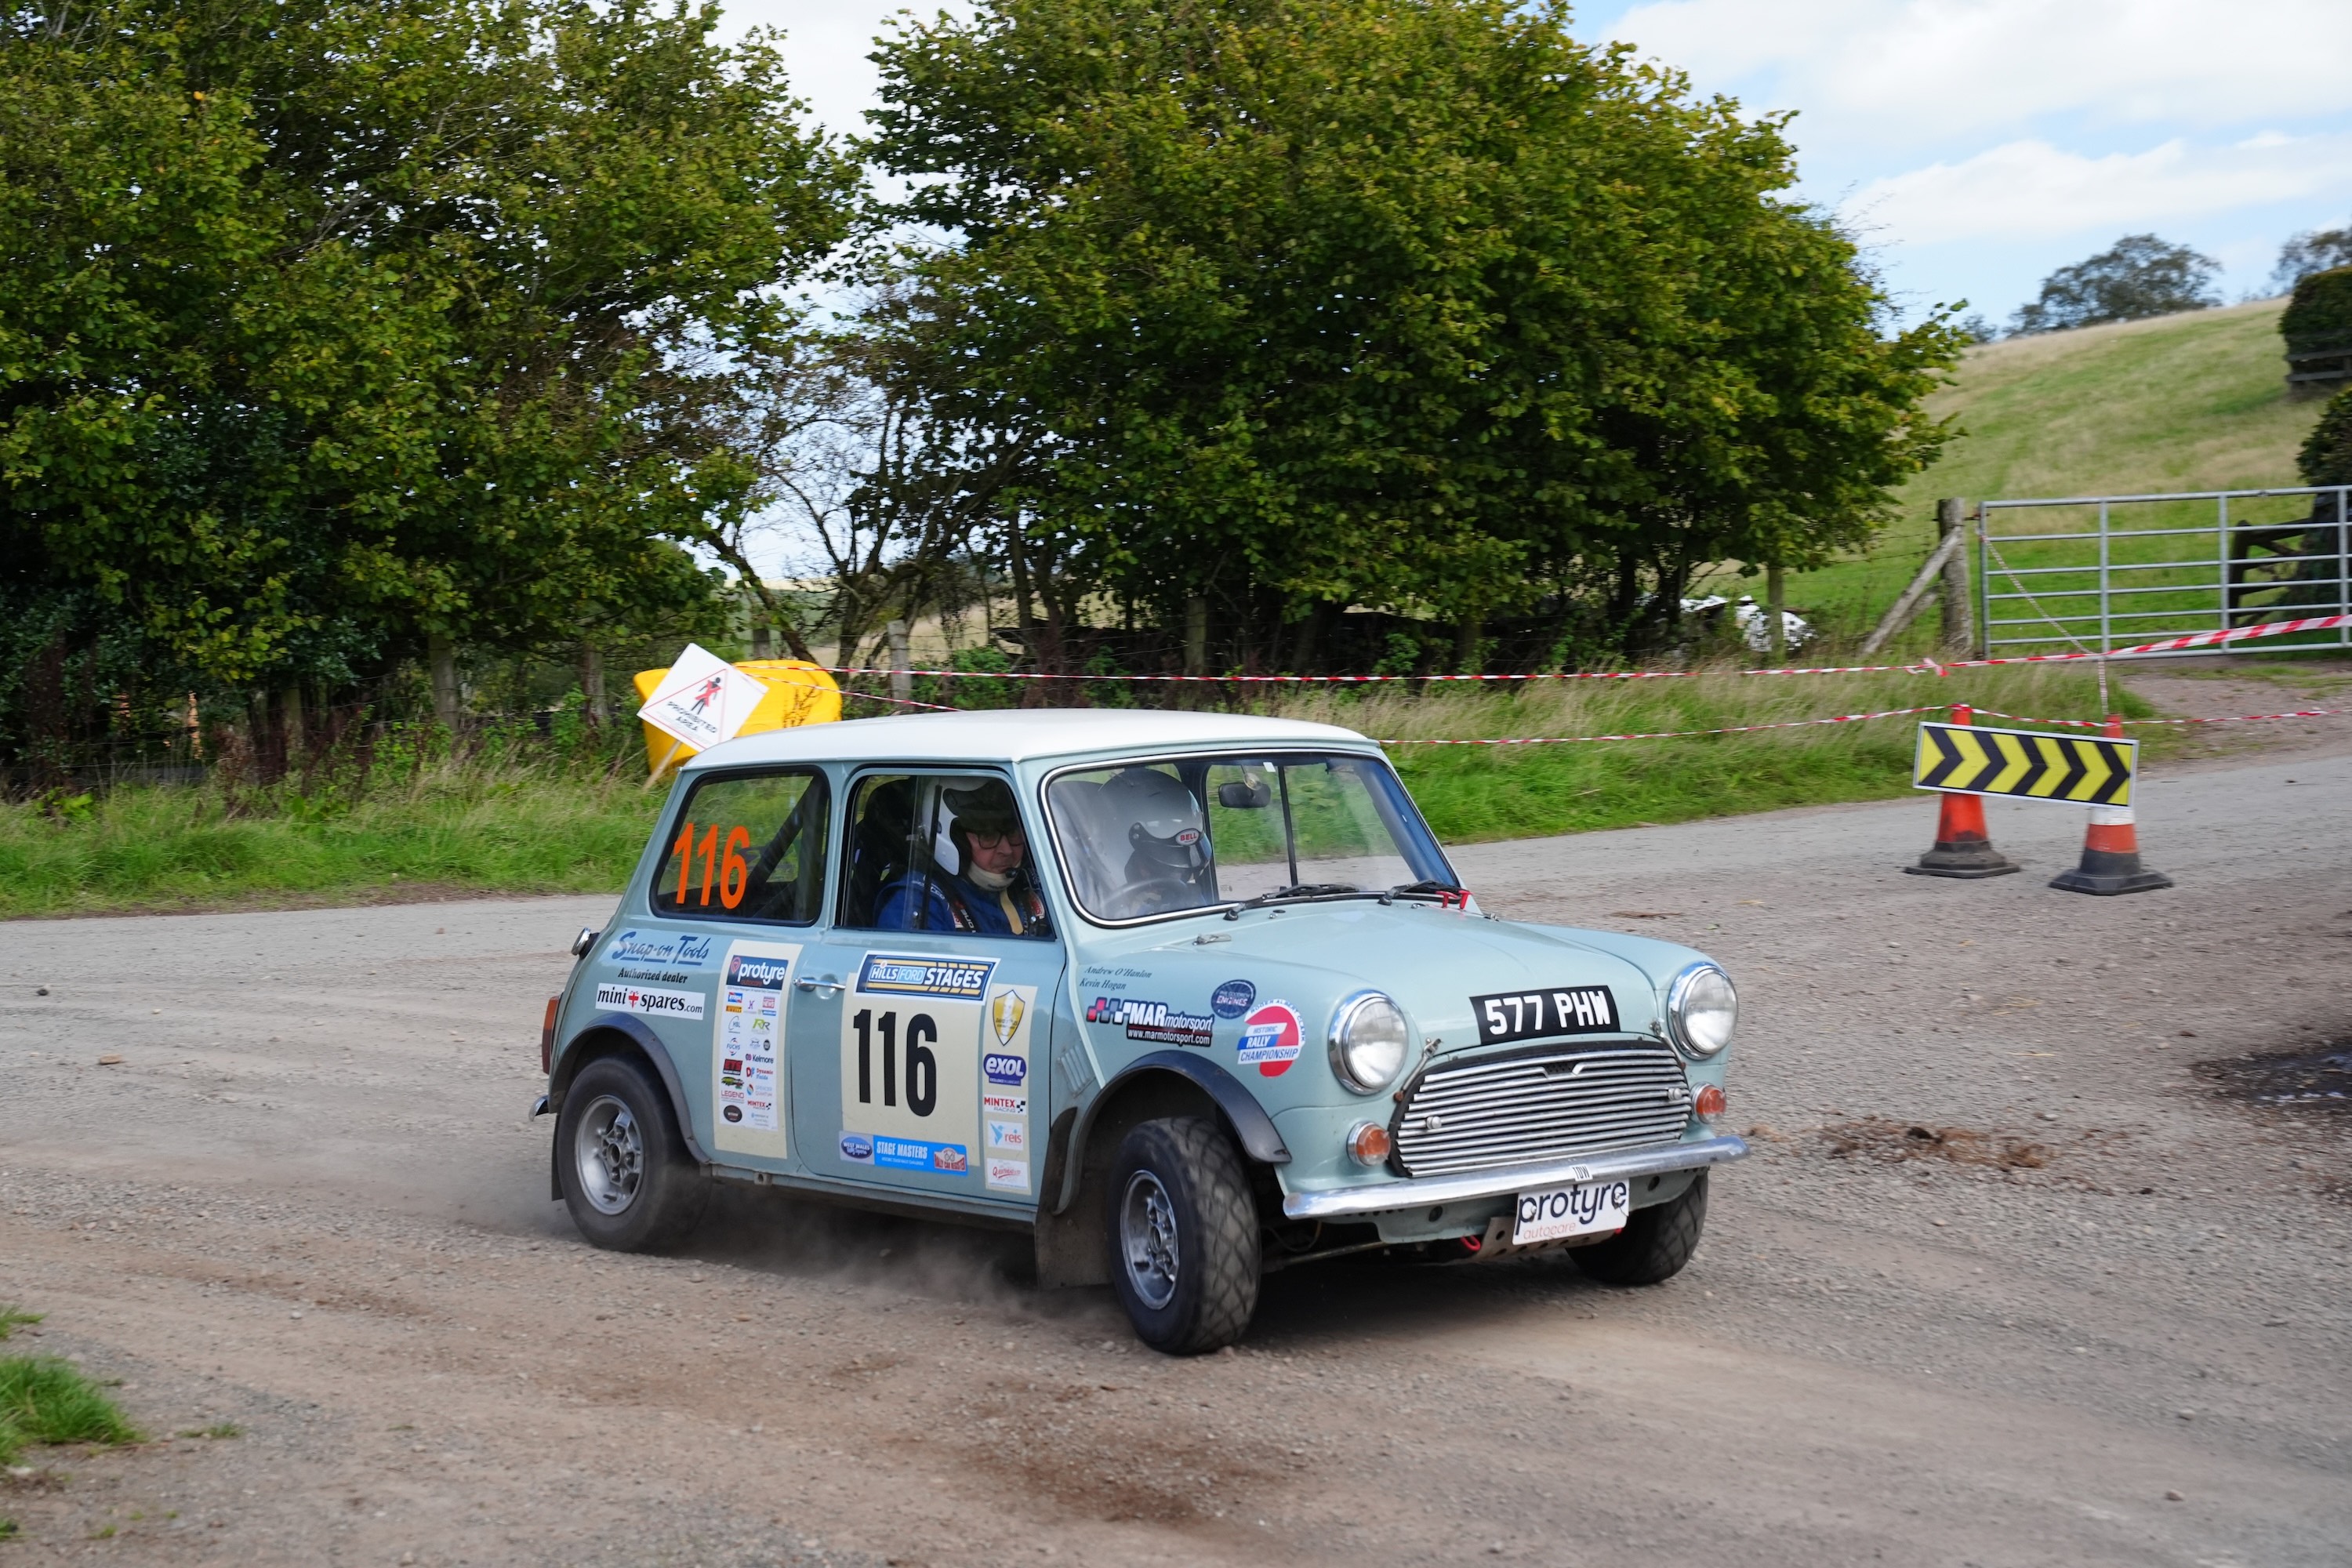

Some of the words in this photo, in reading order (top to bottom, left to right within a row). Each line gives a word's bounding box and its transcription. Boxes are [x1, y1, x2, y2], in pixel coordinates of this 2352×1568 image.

[666, 701, 717, 733] PROHIBITED
[1180, 833, 1197, 841] BELL
[673, 822, 750, 909] 116
[612, 931, 674, 961] Snap-on
[671, 935, 711, 964] Tools
[618, 967, 662, 982] Authorized
[662, 970, 688, 984] dealer
[737, 962, 786, 985] protyre
[924, 967, 985, 989] STAGES
[1084, 965, 1114, 975] Andrew
[1079, 978, 1101, 988] Kevin
[1101, 979, 1127, 991] Hogan
[597, 986, 628, 1005] mini
[640, 993, 702, 1014] spares.com
[1484, 994, 1544, 1036] 577
[1552, 990, 1611, 1029] PHW
[1127, 1029, 1210, 1045] www.marmotorsport.com
[1246, 1035, 1272, 1049] RALLY
[852, 1008, 938, 1117] 116
[1240, 1047, 1298, 1062] CHAMPIONSHIP
[721, 1090, 745, 1099] LEGEND
[984, 1096, 1016, 1109] MINTEX
[1004, 1129, 1022, 1144] reis
[876, 1141, 896, 1156] STAGE
[897, 1143, 928, 1160] MASTERS
[1515, 1181, 1627, 1236] protyre
[1523, 1221, 1576, 1240] autocare
